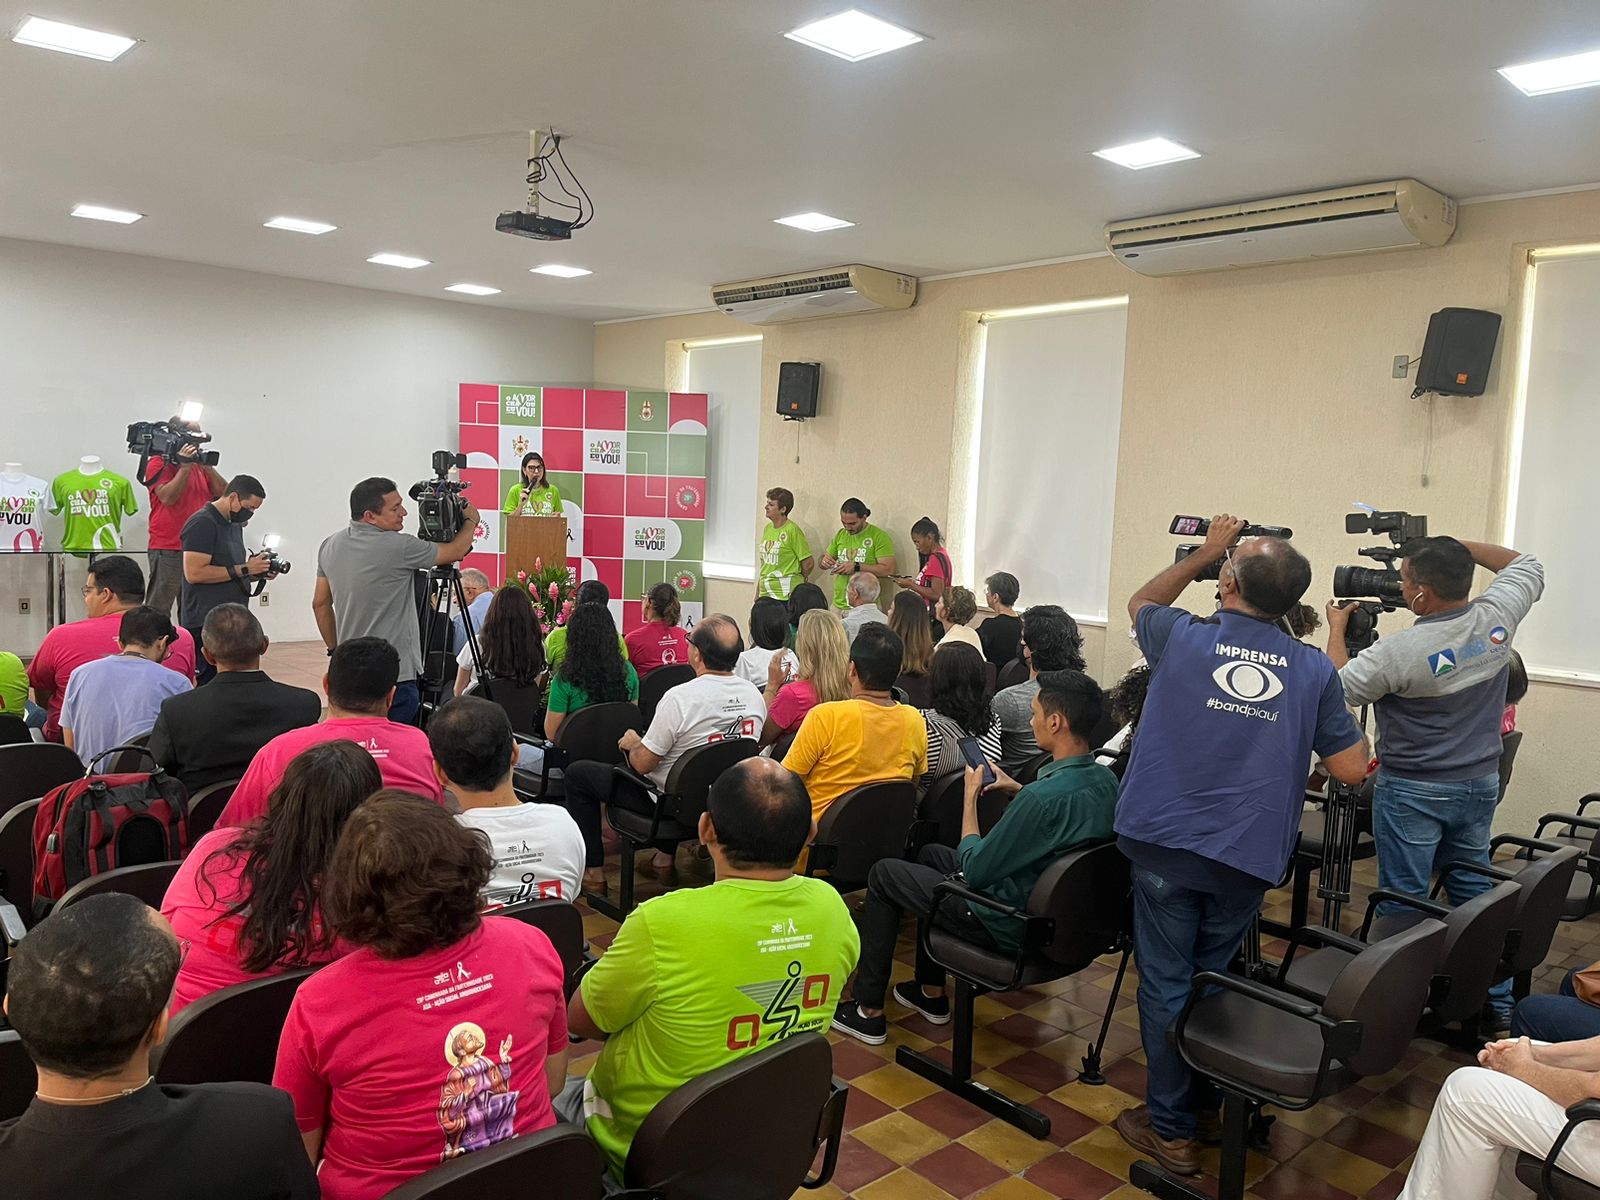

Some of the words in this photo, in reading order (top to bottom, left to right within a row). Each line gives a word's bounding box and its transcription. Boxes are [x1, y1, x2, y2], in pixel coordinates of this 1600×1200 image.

[516, 406, 536, 417] VOU!
[600, 454, 620, 464] VOU!
[82, 505, 110, 517] VOU!
[6, 513, 32, 525] VOU
[646, 540, 665, 550] VOU!
[1215, 643, 1288, 668] IMPRENSA
[1206, 698, 1280, 722] #bandpiauí
